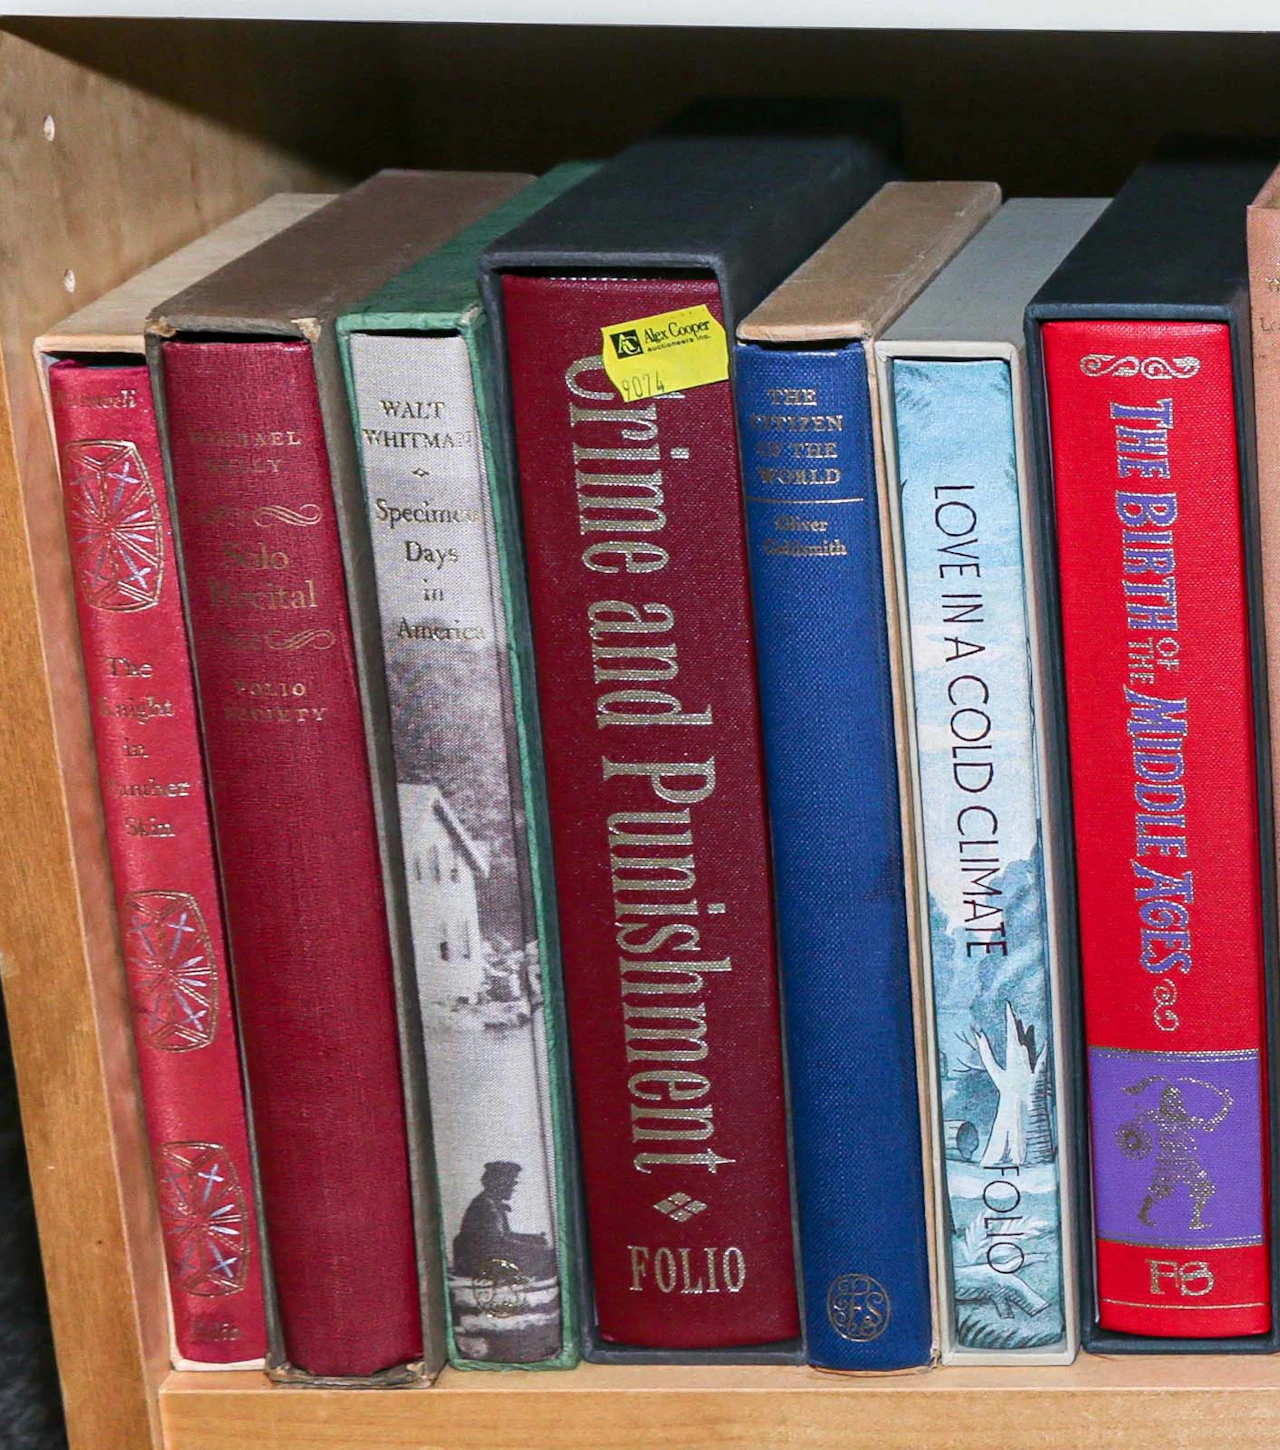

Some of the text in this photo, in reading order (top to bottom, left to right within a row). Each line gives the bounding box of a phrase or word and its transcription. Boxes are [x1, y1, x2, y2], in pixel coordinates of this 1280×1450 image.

[644, 321, 711, 344] Alex Cooper
[647, 337, 695, 352] auctioneers
[621, 370, 666, 400] 9074
[767, 388, 818, 406] THE
[379, 400, 445, 420] WALT
[791, 442, 838, 459] THE
[758, 467, 842, 485] WORLD
[404, 540, 460, 571] Days
[422, 578, 445, 602] in
[396, 616, 488, 641] America
[587, 600, 714, 728] and
[1109, 397, 1194, 978] THE BIRTH OF THE MIDDLE AGES
[933, 485, 1009, 958] LOVE IN A COLD CLIMATE
[600, 753, 737, 1175] Punishment
[982, 1165, 1026, 1276] FOLIO
[627, 1245, 747, 1295] FOLIO
